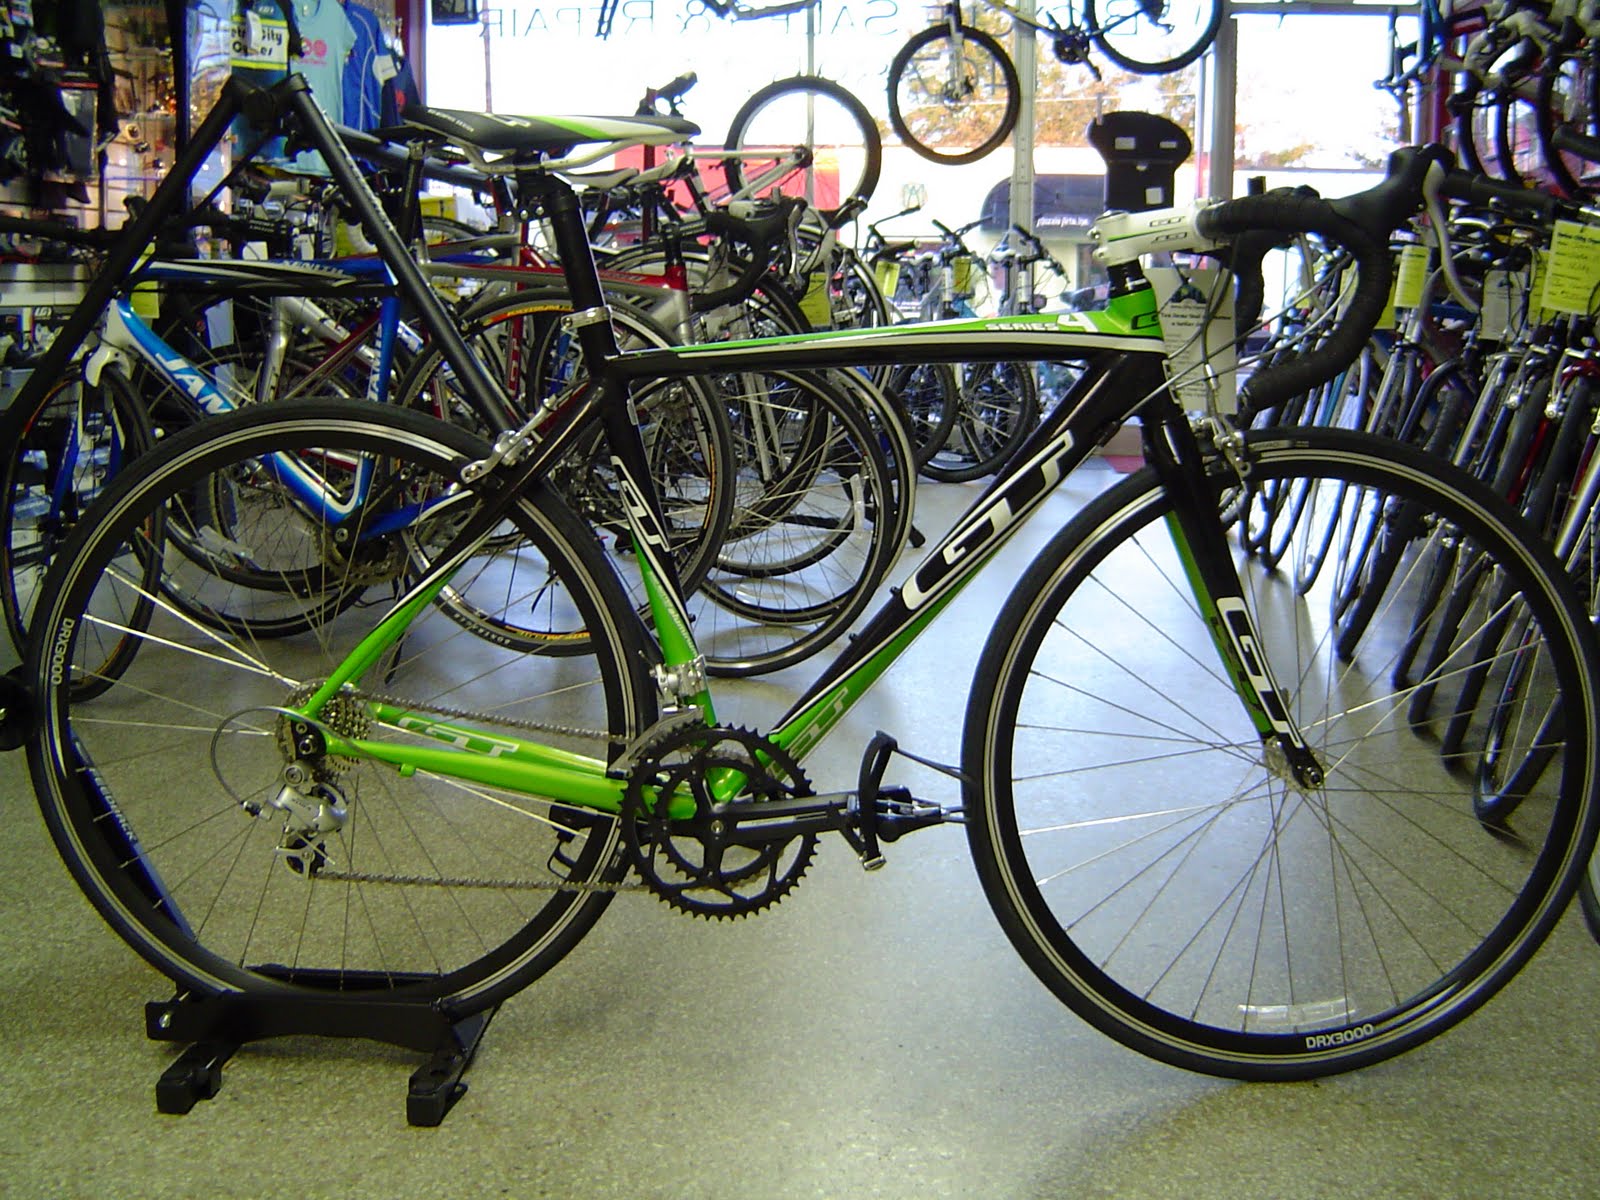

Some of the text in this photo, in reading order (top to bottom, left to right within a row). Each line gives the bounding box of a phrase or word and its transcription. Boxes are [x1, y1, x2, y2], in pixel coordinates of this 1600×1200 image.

[985, 312, 1099, 333] SERIES 4
[901, 428, 1076, 611] GT
[50, 617, 76, 686] DRX3000
[1215, 596, 1305, 749] GT
[1305, 1022, 1375, 1050] DRX3000
